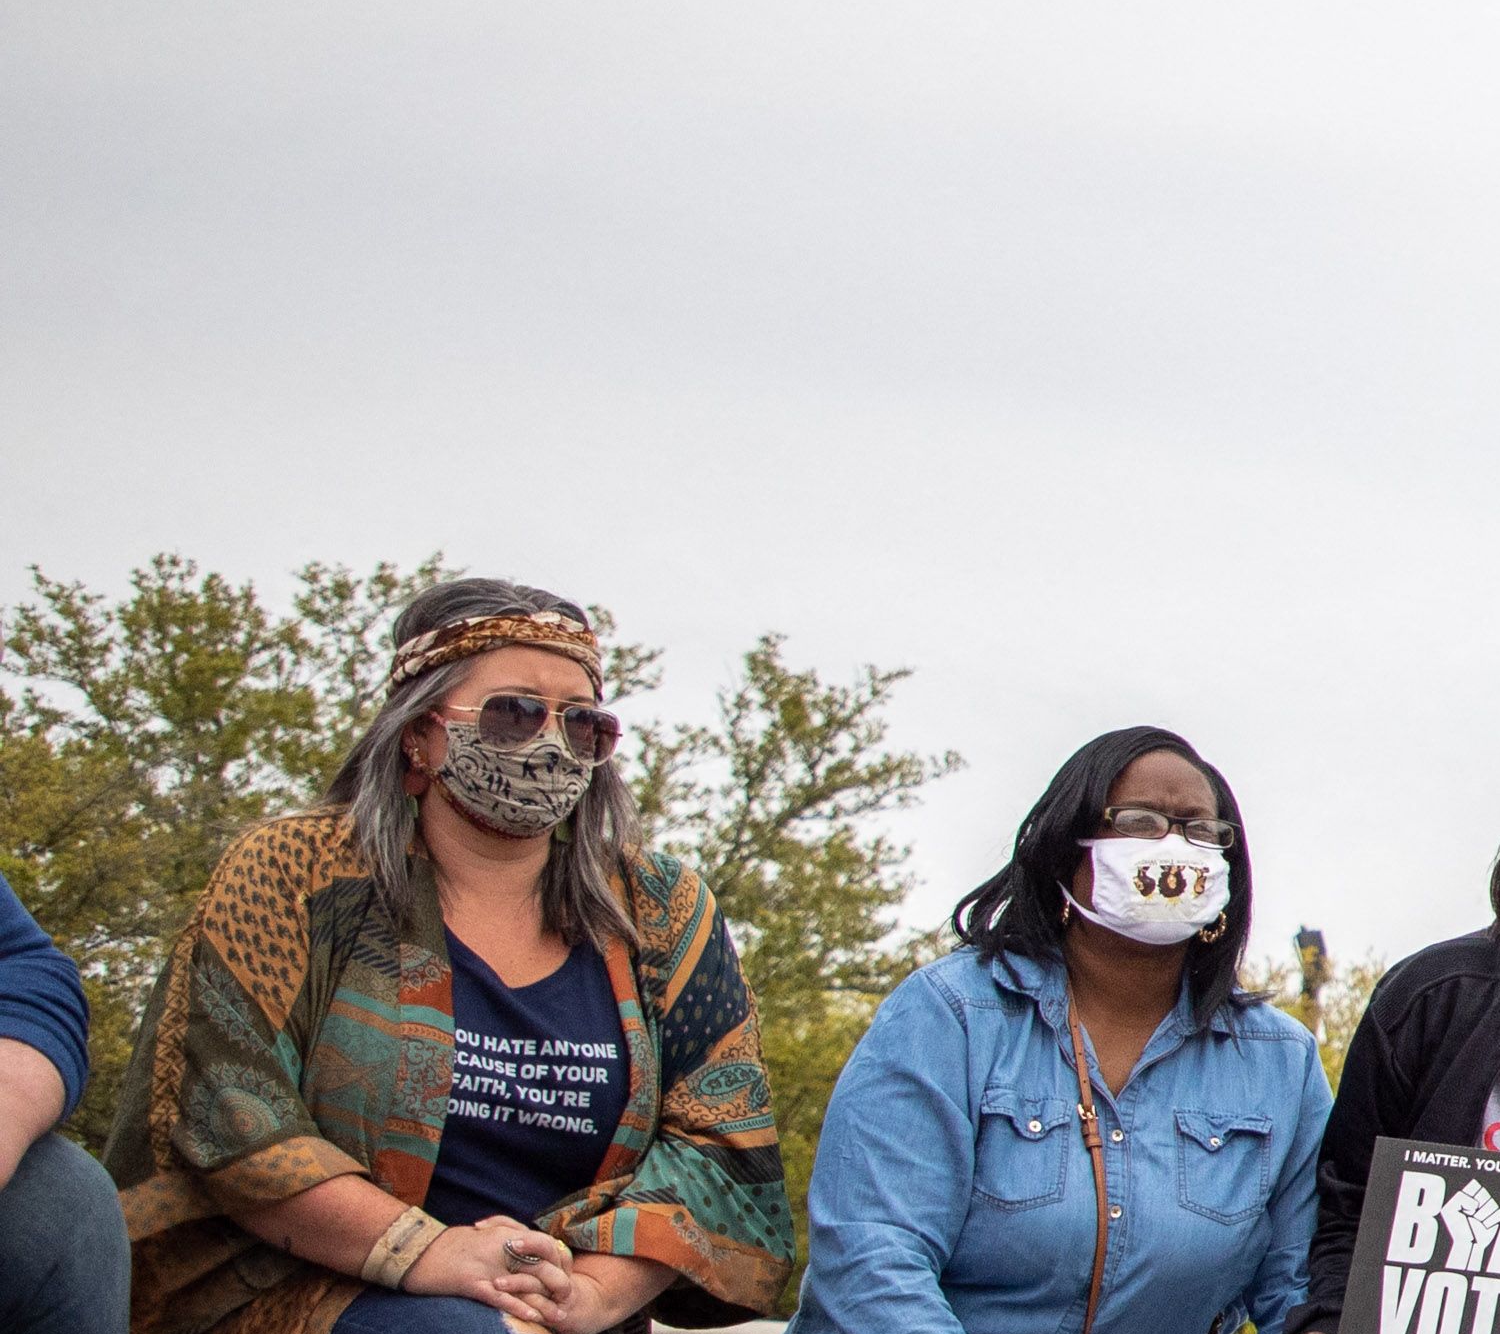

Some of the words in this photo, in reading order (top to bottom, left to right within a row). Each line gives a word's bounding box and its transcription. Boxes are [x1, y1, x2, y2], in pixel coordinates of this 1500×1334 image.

[455, 1029, 480, 1047] OU
[484, 1037, 536, 1055] HATE
[540, 1040, 618, 1059] ANYONE
[454, 1050, 517, 1078] CAUSE
[520, 1064, 549, 1080] OF
[553, 1066, 609, 1084] YOUR
[452, 1073, 512, 1100] FAITH,
[516, 1084, 591, 1108] YOU'RE
[447, 1099, 490, 1118] OING
[494, 1106, 515, 1122] IT
[518, 1110, 598, 1134] WRONG.
[1404, 1150, 1410, 1161] I
[1413, 1151, 1471, 1169] MATTER.
